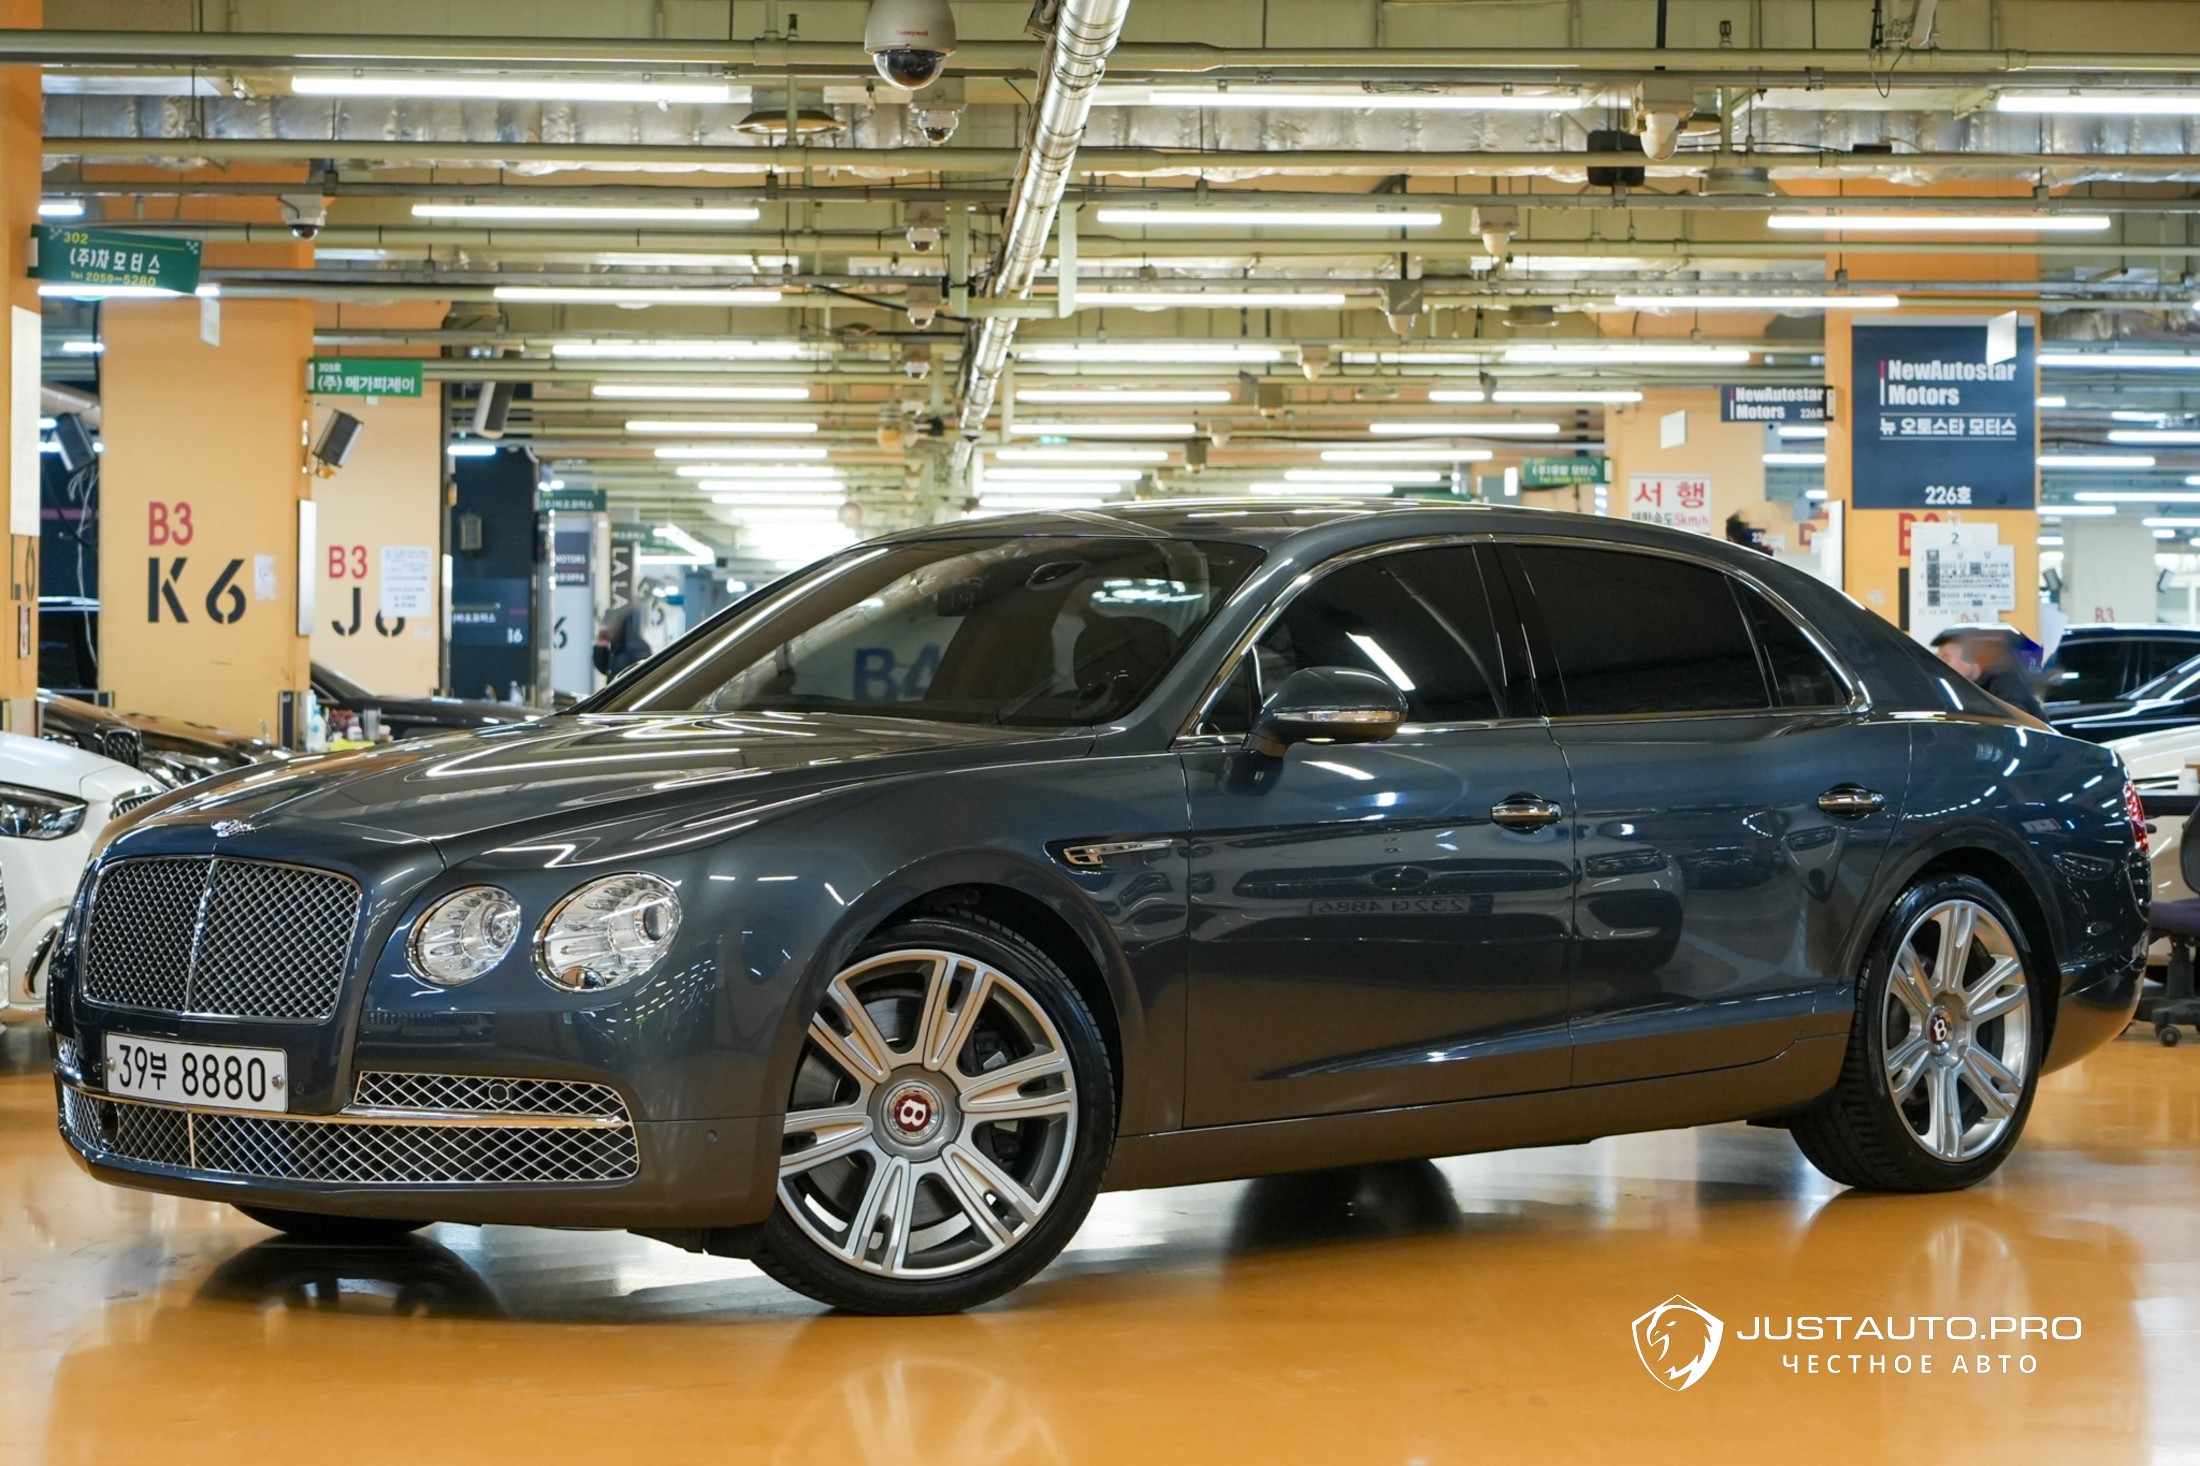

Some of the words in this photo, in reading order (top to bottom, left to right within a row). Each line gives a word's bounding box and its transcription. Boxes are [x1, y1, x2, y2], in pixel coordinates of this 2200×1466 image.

[64, 231, 89, 244] 302
[1888, 360, 2017, 380] NewAutostar
[1735, 387, 1824, 402] NewAutostar
[1888, 384, 1960, 405] Motors
[1735, 404, 1785, 419] Motors
[1880, 417, 1897, 435] 뉴
[1969, 417, 2017, 435] 모터스
[1925, 485, 1972, 505] 226호
[149, 502, 194, 545] B3
[328, 545, 368, 579] B3
[119, 1044, 167, 1091] 39부
[181, 1052, 266, 1102] 8880
